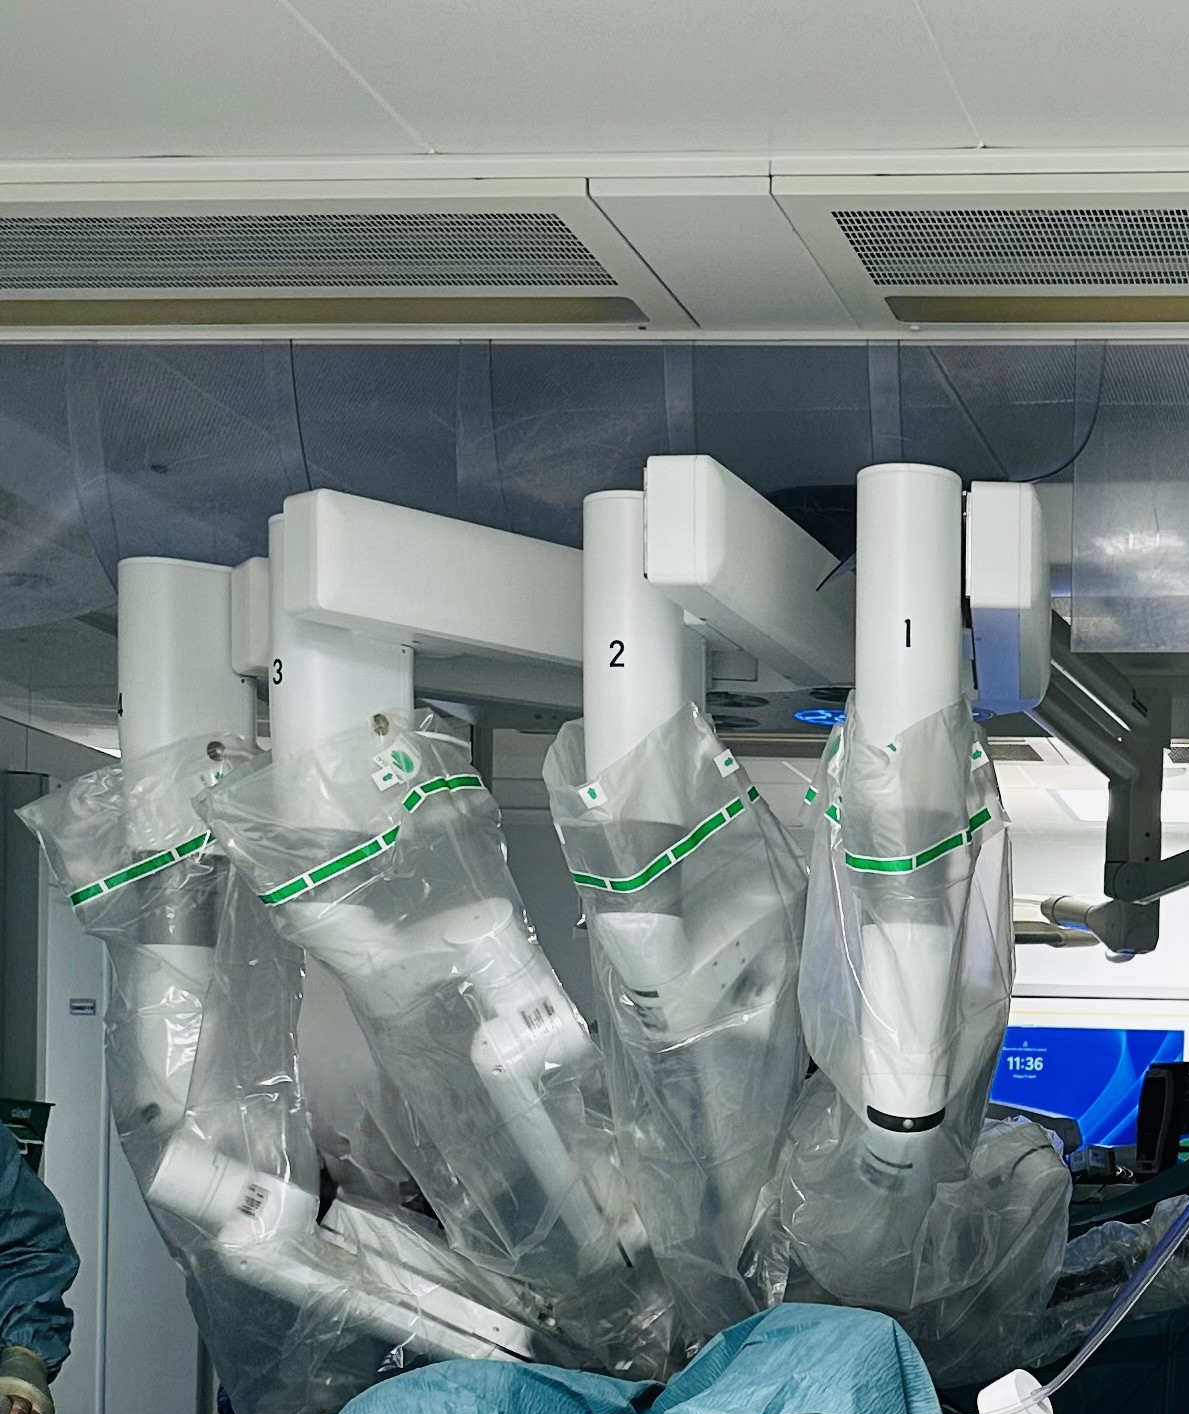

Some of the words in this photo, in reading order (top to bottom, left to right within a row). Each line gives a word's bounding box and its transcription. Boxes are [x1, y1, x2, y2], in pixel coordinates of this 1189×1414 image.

[903, 619, 912, 648] 1
[609, 639, 625, 668] 2
[272, 658, 283, 686] 3
[1006, 1055, 1044, 1072] 11:36
